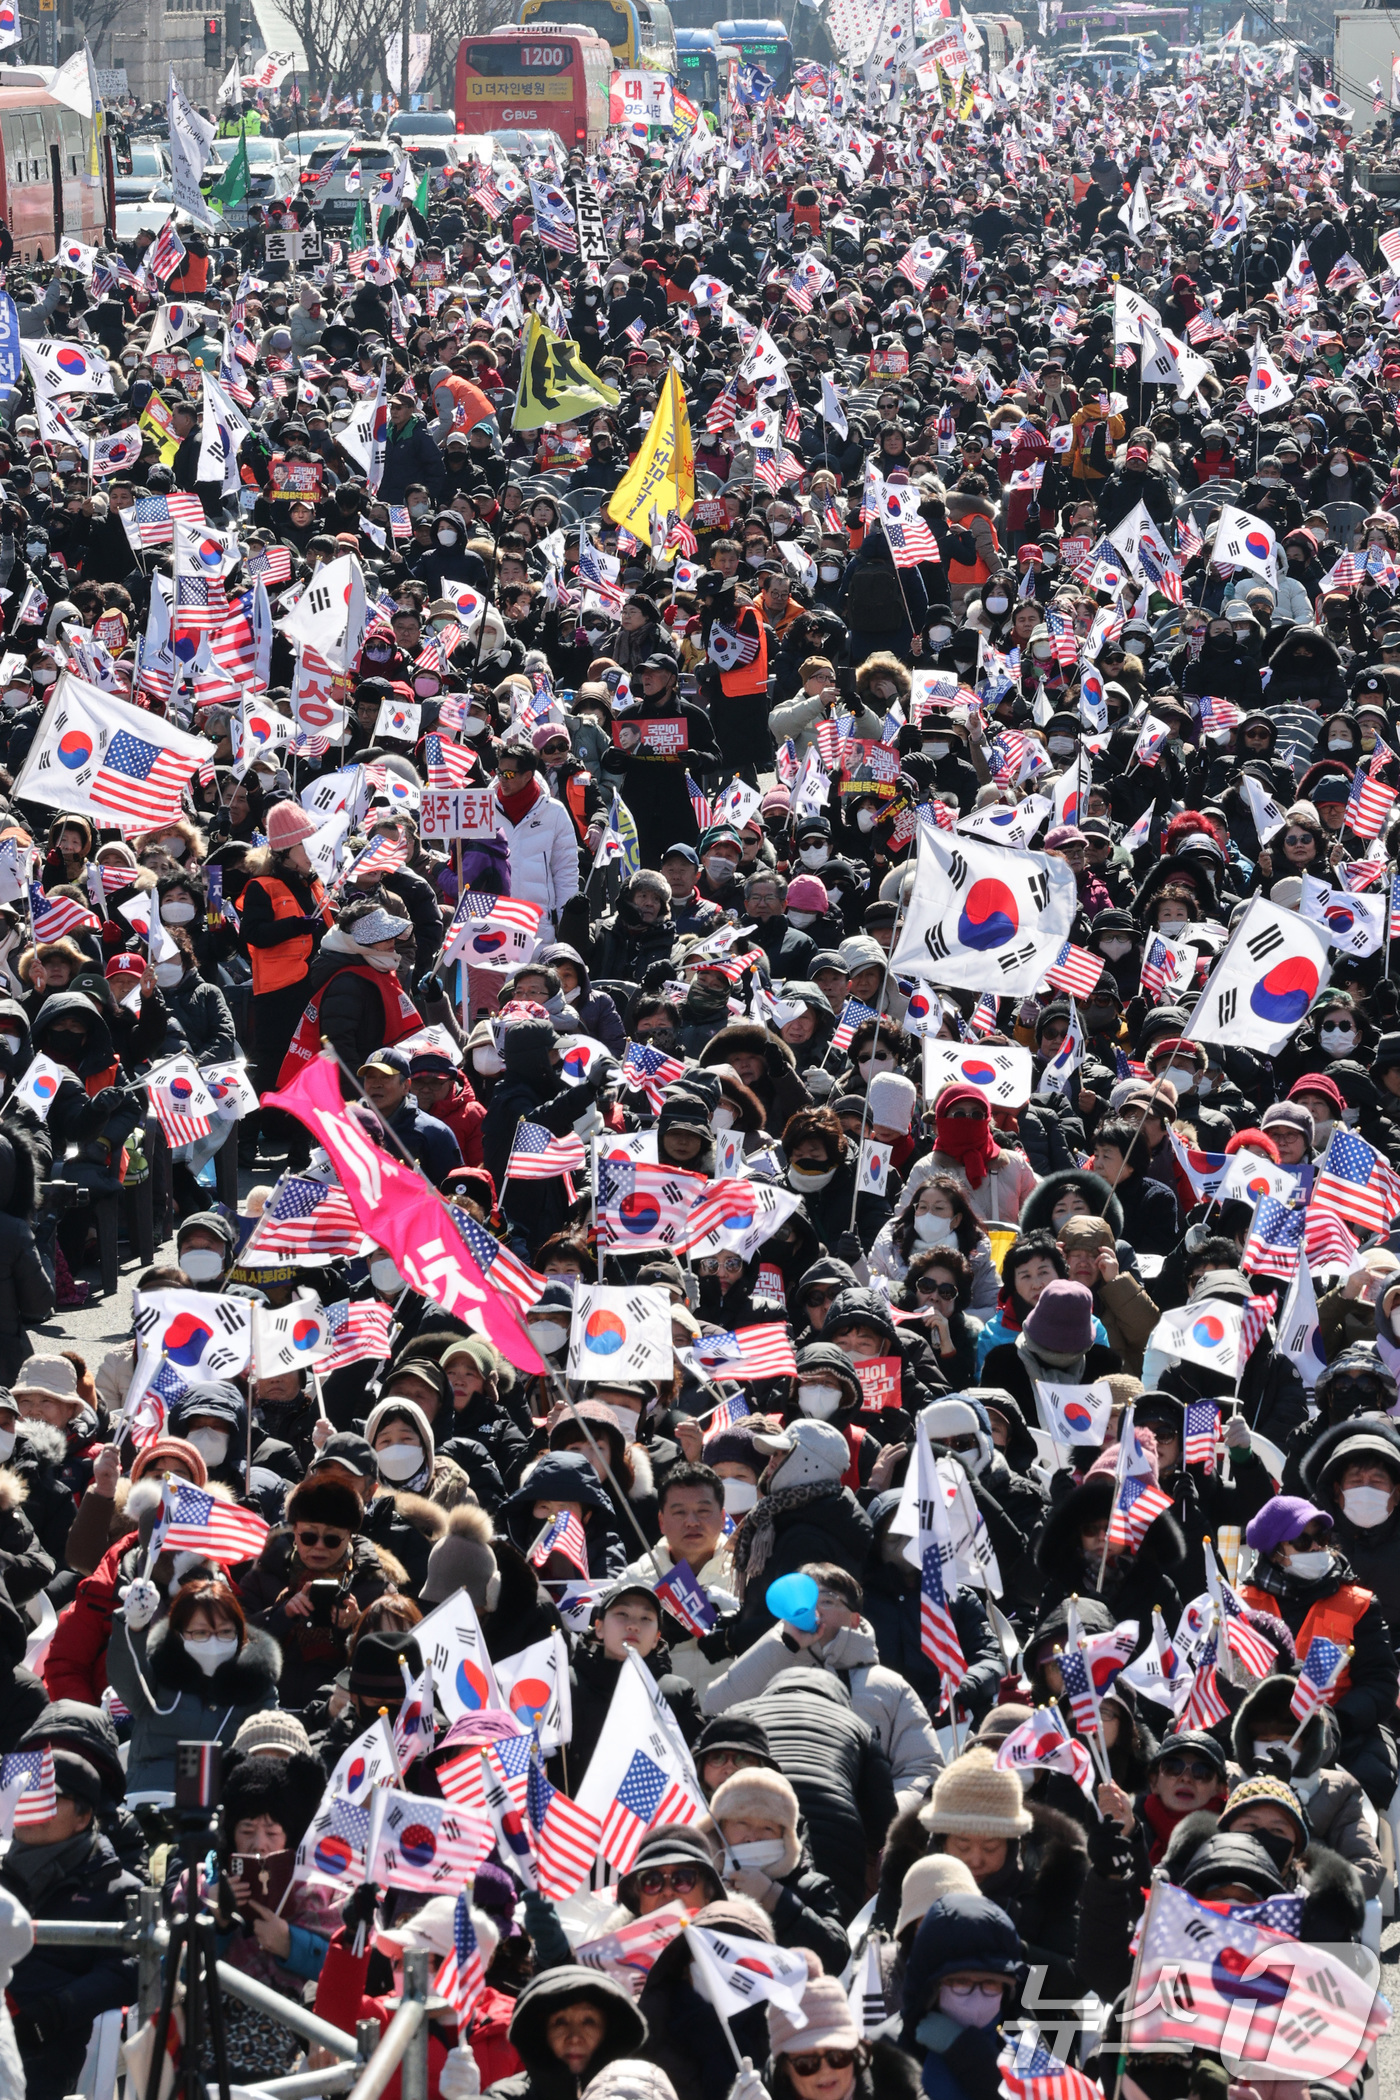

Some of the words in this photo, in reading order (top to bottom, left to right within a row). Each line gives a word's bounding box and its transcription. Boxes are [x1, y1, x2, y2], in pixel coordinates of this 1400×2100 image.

[523, 48, 562, 65] 1200
[485, 82, 545, 96] 더자인병원
[578, 186, 609, 261] 춘천
[698, 502, 720, 512] 국민이
[696, 509, 725, 521] 지켜보고
[648, 724, 679, 735] 국민이
[643, 734, 684, 746] 지켜보고
[871, 745, 894, 763] 국민이
[865, 757, 899, 775] 지켜보고
[118, 955, 131, 969] NY
[82, 979, 93, 987] C
[248, 1267, 297, 1284] 사퇴하
[755, 1271, 782, 1291] 민이
[855, 1363, 886, 1382] 민이
